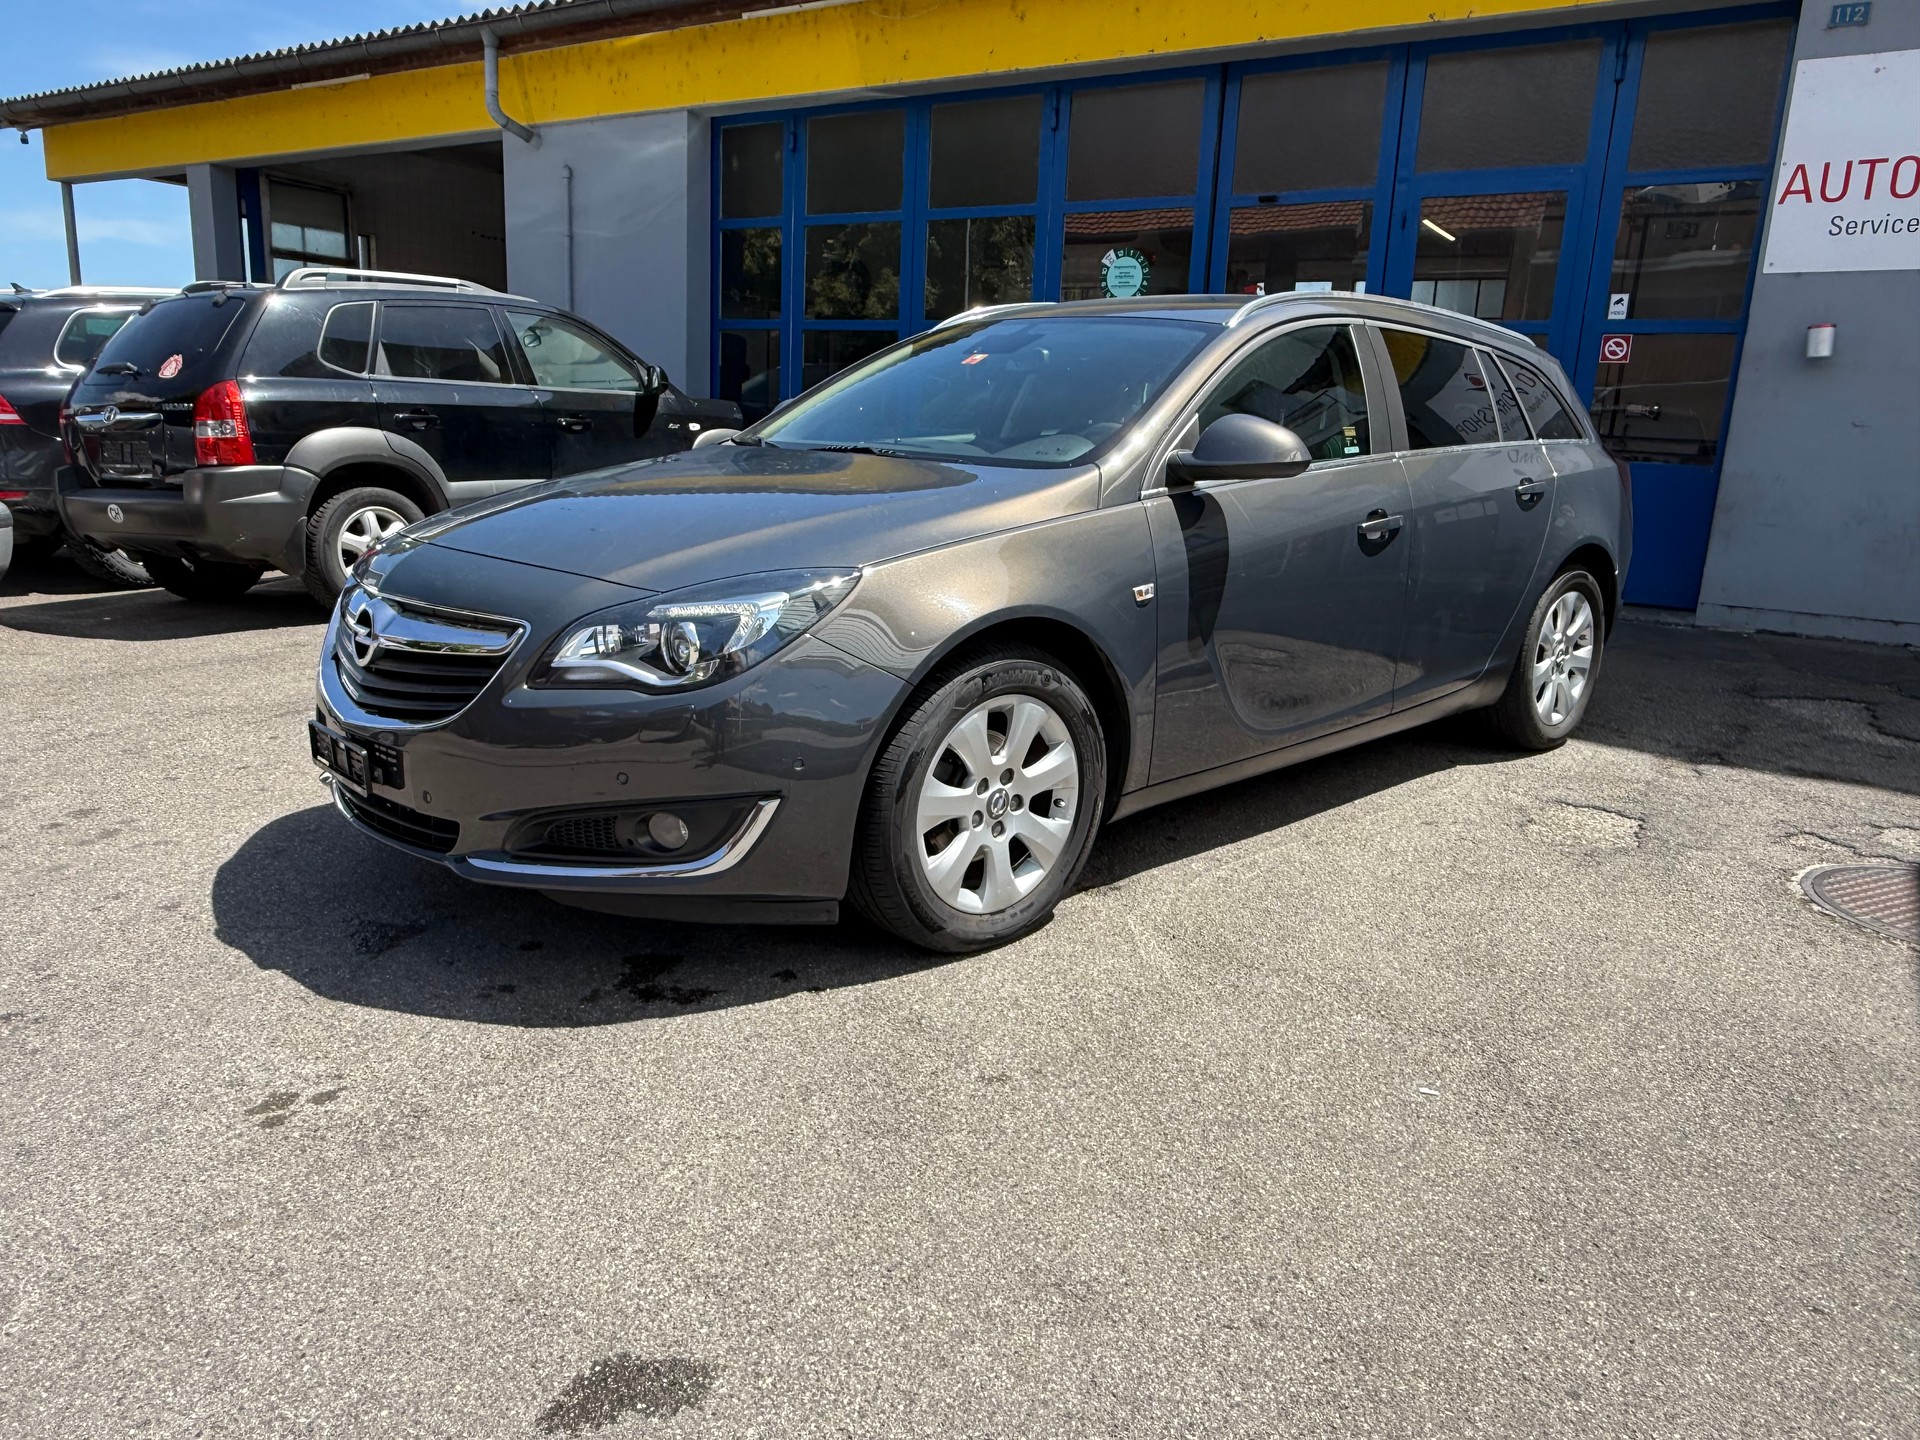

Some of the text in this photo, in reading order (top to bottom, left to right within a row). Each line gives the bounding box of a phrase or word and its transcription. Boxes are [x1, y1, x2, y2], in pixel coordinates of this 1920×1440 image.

[1835, 5, 1865, 23] 112
[1777, 155, 1920, 205] AUTO
[1828, 213, 1920, 236] Service
[109, 506, 122, 520] CH
